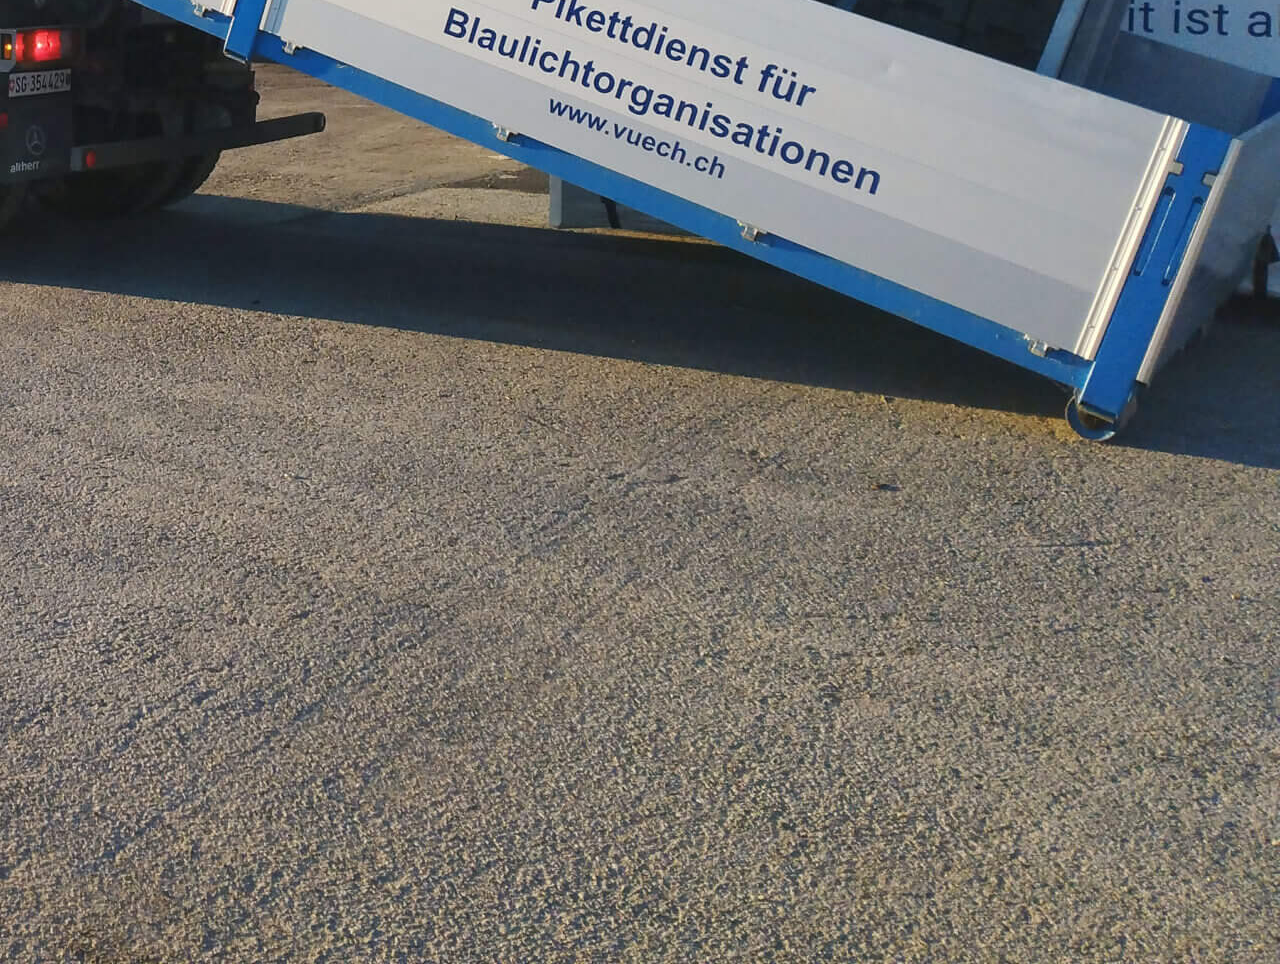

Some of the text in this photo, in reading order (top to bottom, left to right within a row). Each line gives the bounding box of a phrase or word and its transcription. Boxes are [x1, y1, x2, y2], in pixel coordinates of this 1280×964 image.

[1173, 0, 1230, 36] ist
[443, 7, 882, 196] Blaulichtorganisationen
[759, 63, 817, 108] für
[548, 97, 727, 180] www.vuech.ch
